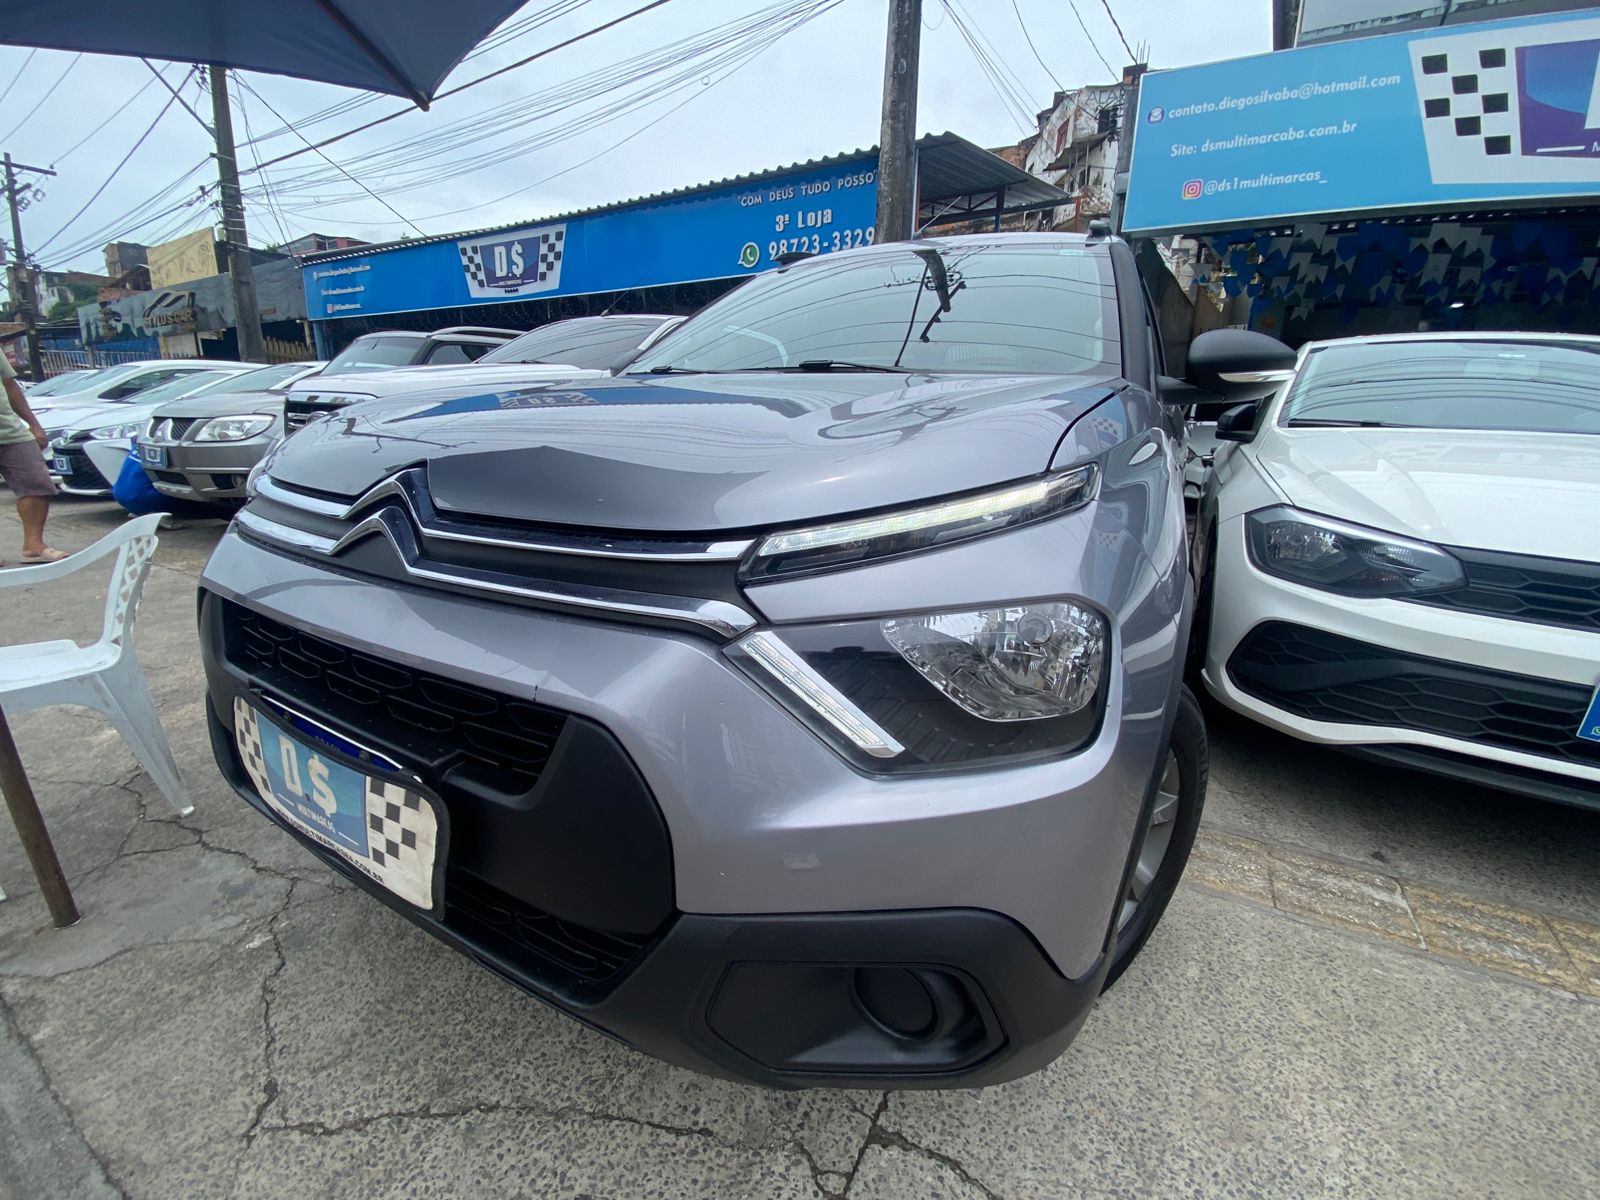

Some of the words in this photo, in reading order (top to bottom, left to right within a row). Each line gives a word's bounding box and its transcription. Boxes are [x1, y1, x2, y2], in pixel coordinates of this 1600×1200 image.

[1168, 75, 1401, 119] contato.diegosilvaba@hotmail.com
[1170, 144, 1198, 157] Site:
[1201, 120, 1357, 153] dsmultimarcaba.com.br
[769, 187, 794, 202] DEUS
[801, 181, 830, 196] TUDO
[1204, 170, 1328, 195] @ds1multimarcas_
[768, 226, 876, 261] 98723-3329
